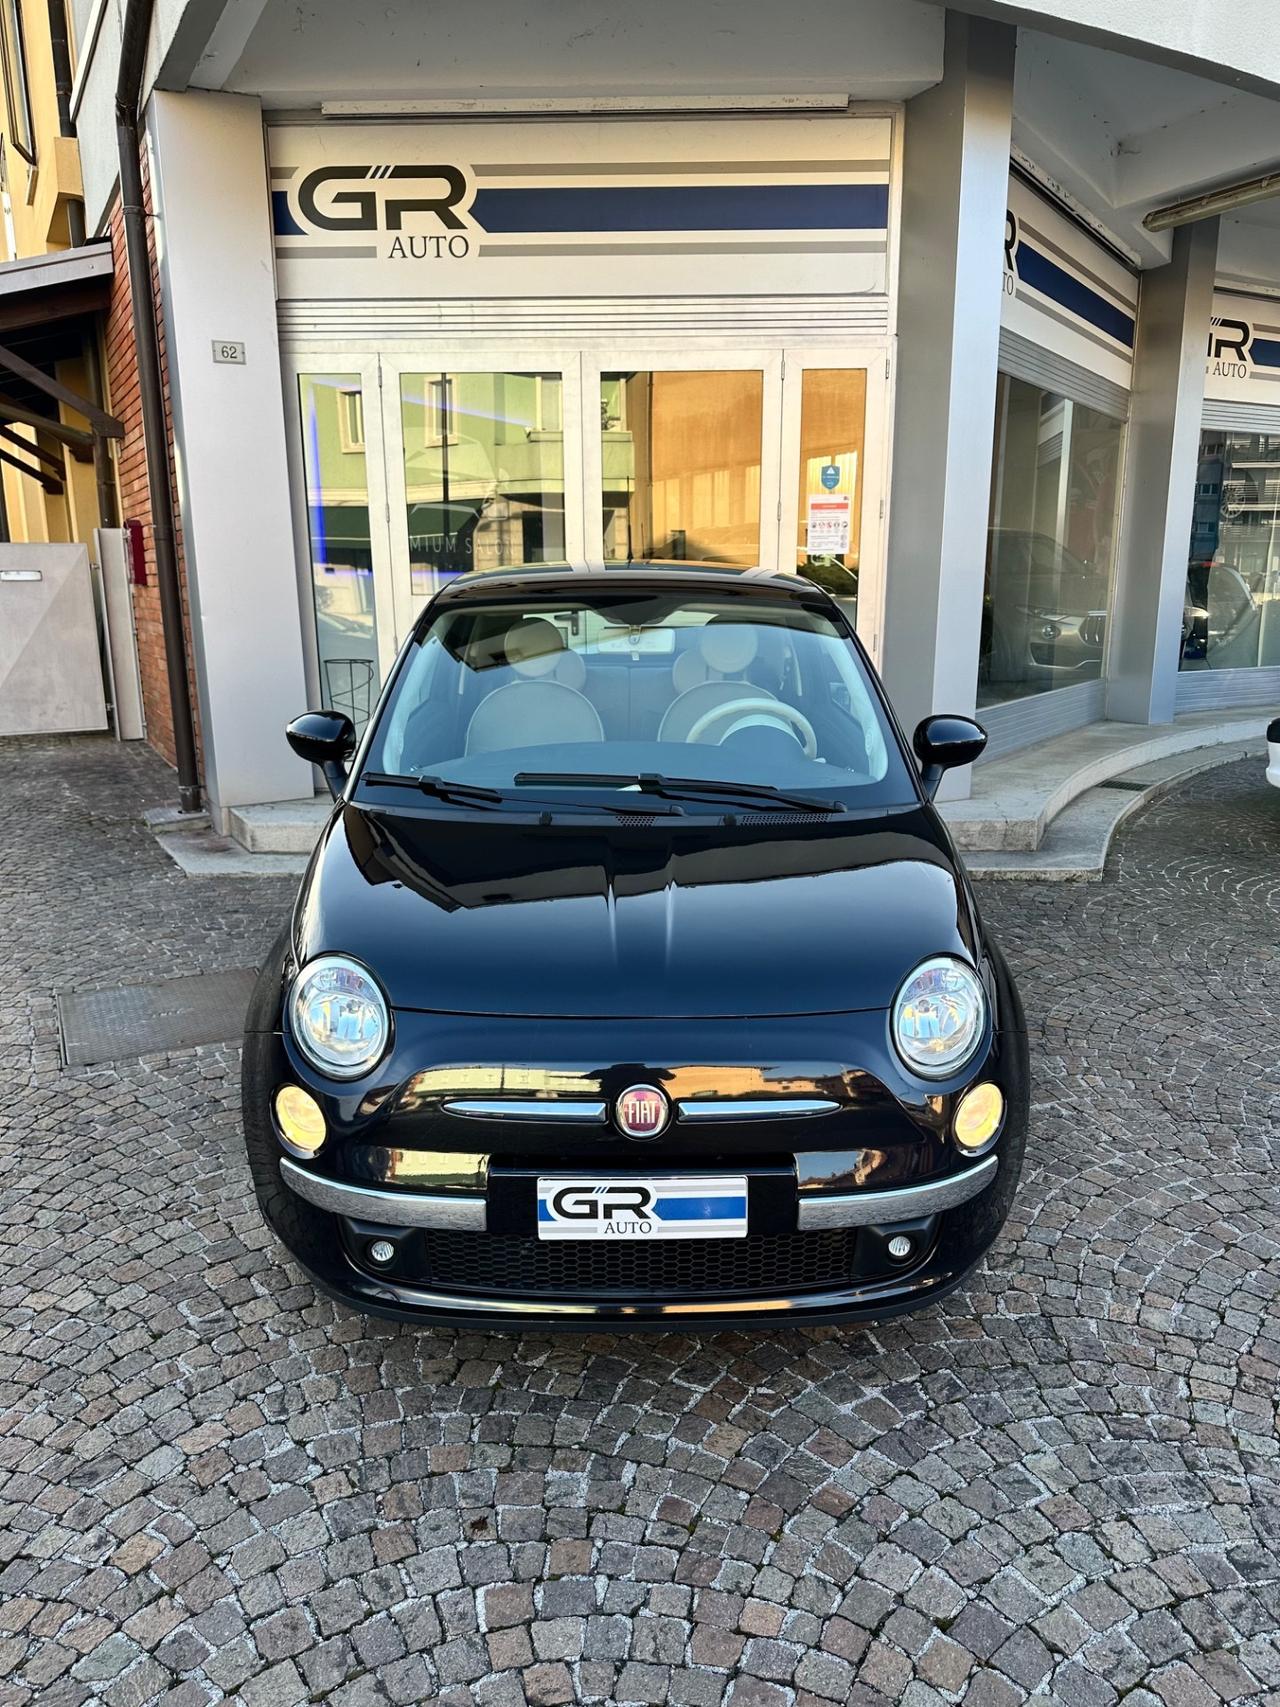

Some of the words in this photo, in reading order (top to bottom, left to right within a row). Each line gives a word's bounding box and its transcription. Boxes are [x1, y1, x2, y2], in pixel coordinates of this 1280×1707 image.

[298, 164, 468, 231] GR
[388, 235, 469, 259] AUTO
[1207, 316, 1250, 361] R
[221, 346, 238, 359] 62
[1212, 361, 1247, 379] AUTO
[410, 536, 456, 554] MIUM
[627, 1101, 658, 1124] FIAT
[552, 1186, 652, 1220] GR
[604, 1221, 652, 1235] AUTO
